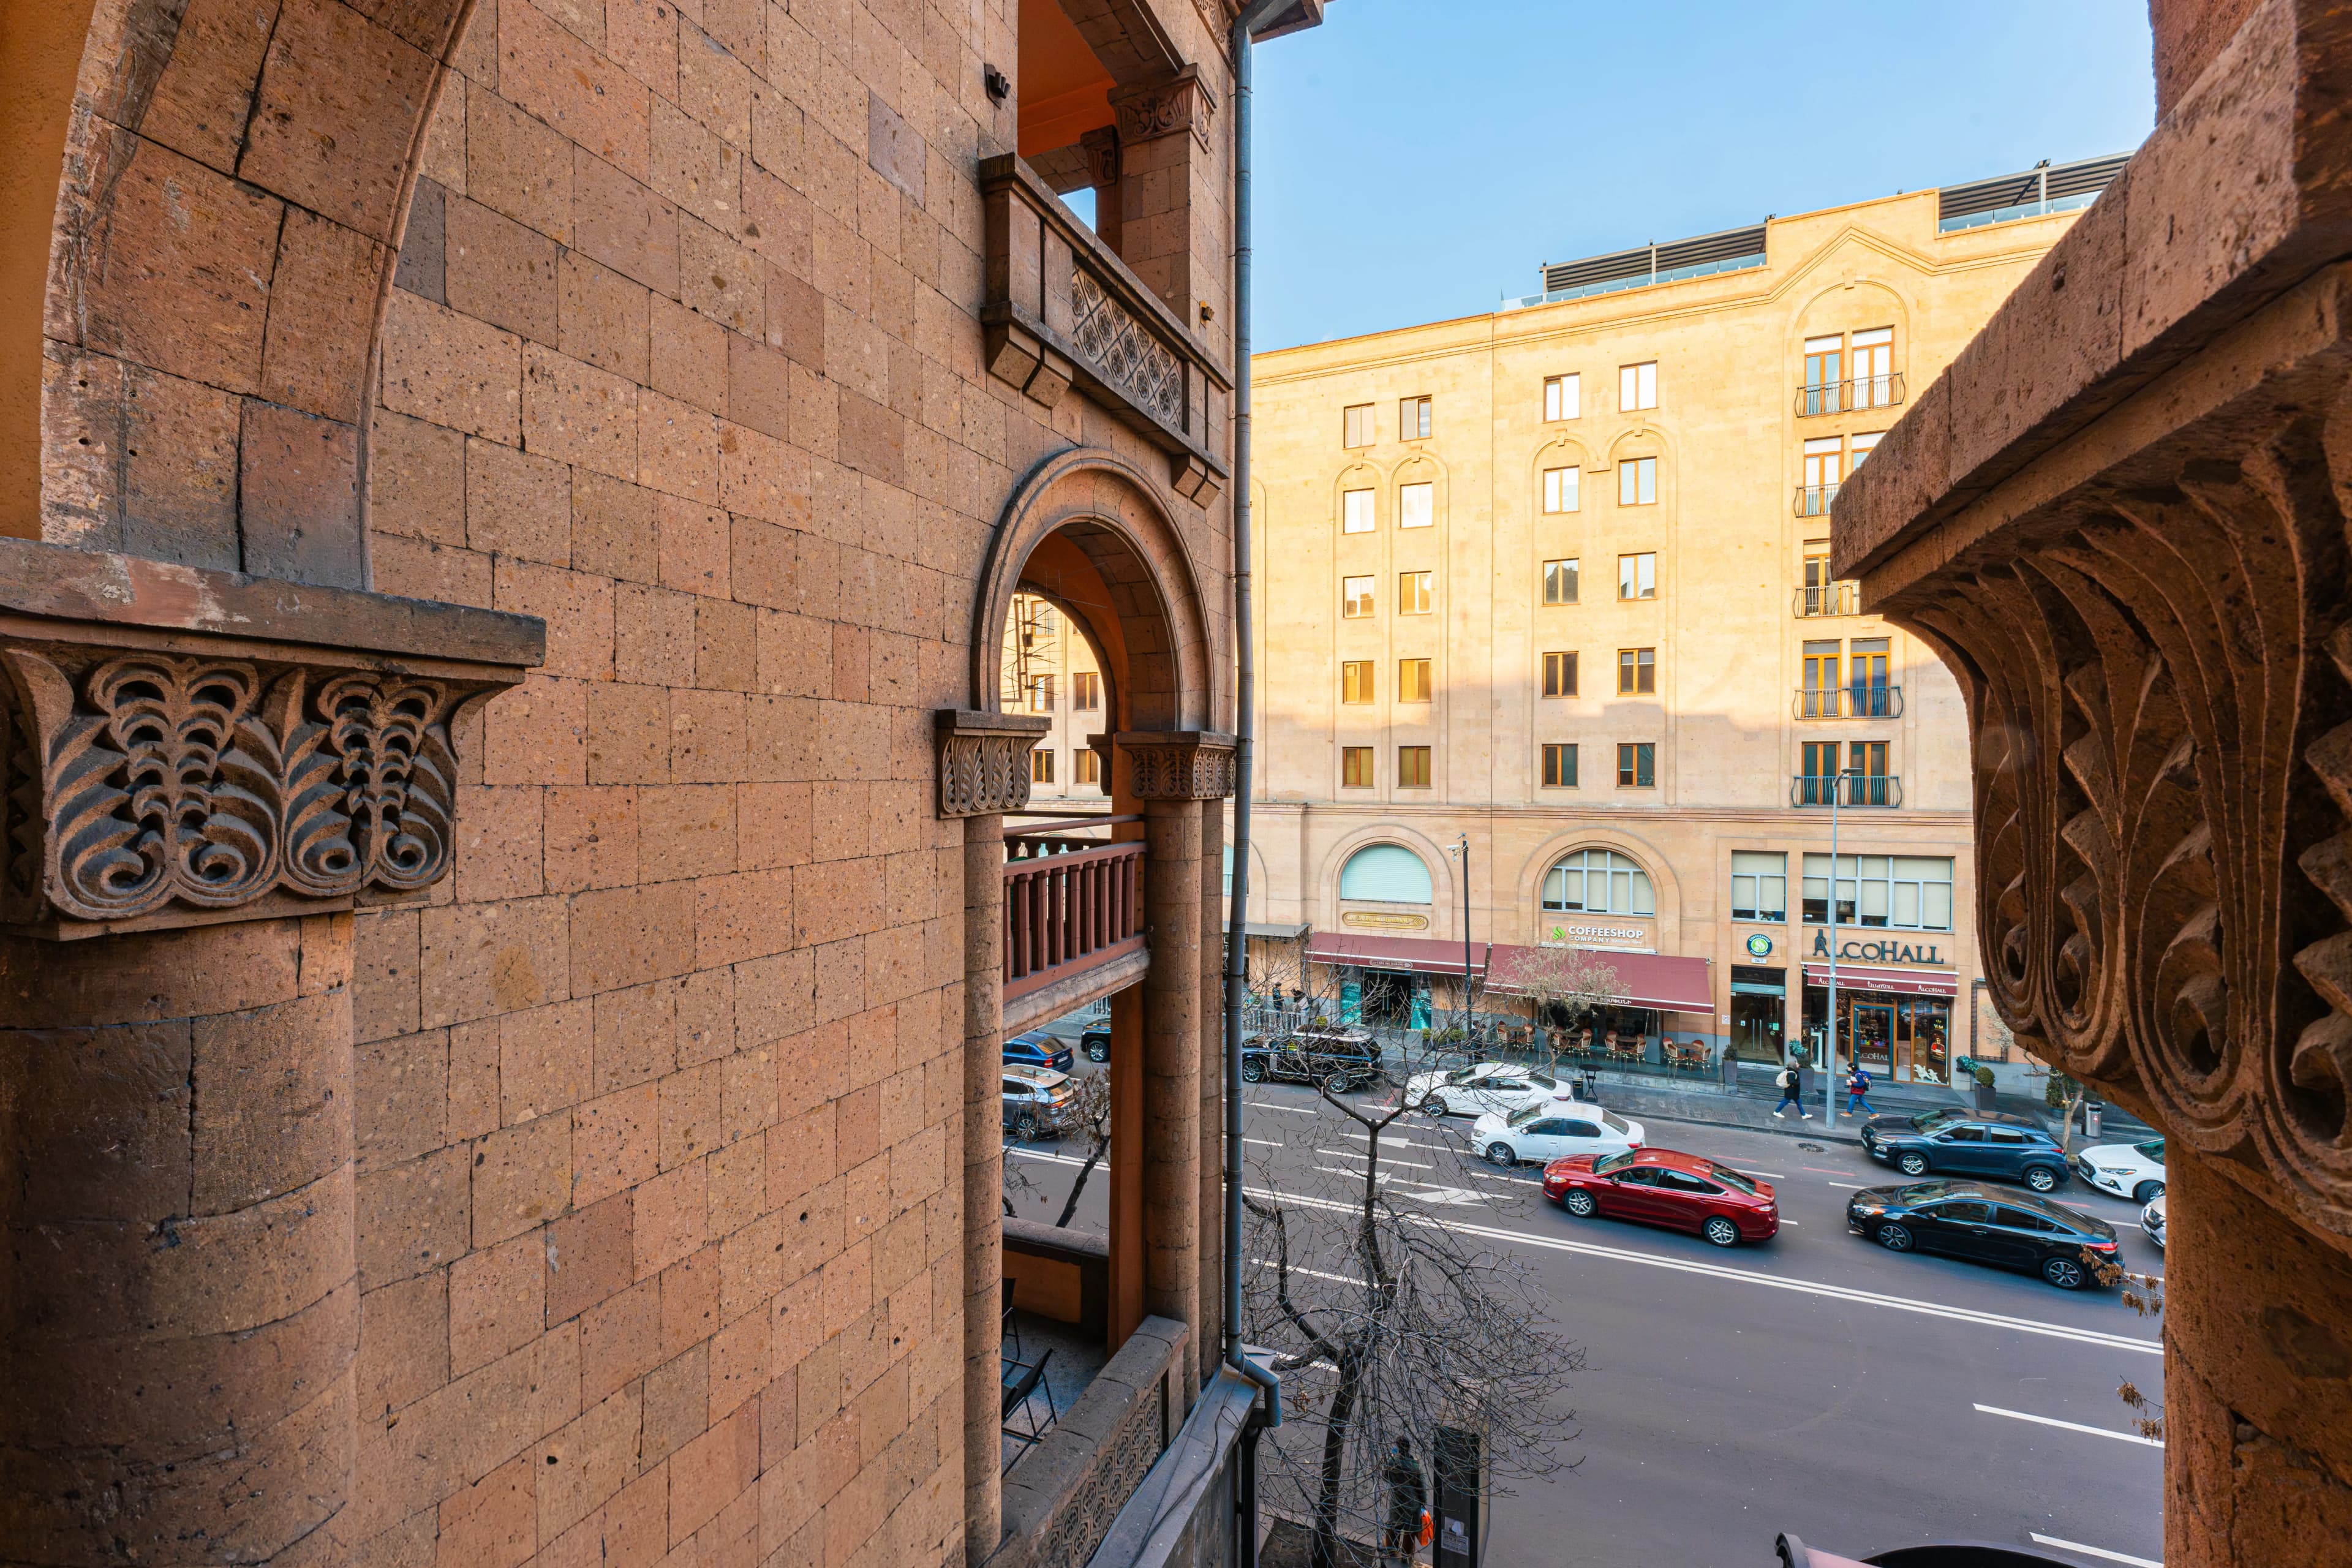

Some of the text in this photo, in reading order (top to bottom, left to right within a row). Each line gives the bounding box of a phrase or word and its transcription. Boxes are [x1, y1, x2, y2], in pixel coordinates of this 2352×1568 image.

[1568, 926, 1643, 939] COFFEESHOP
[1818, 977, 1845, 986] ALCALL
[1917, 984, 1947, 993] ALCOHALL
